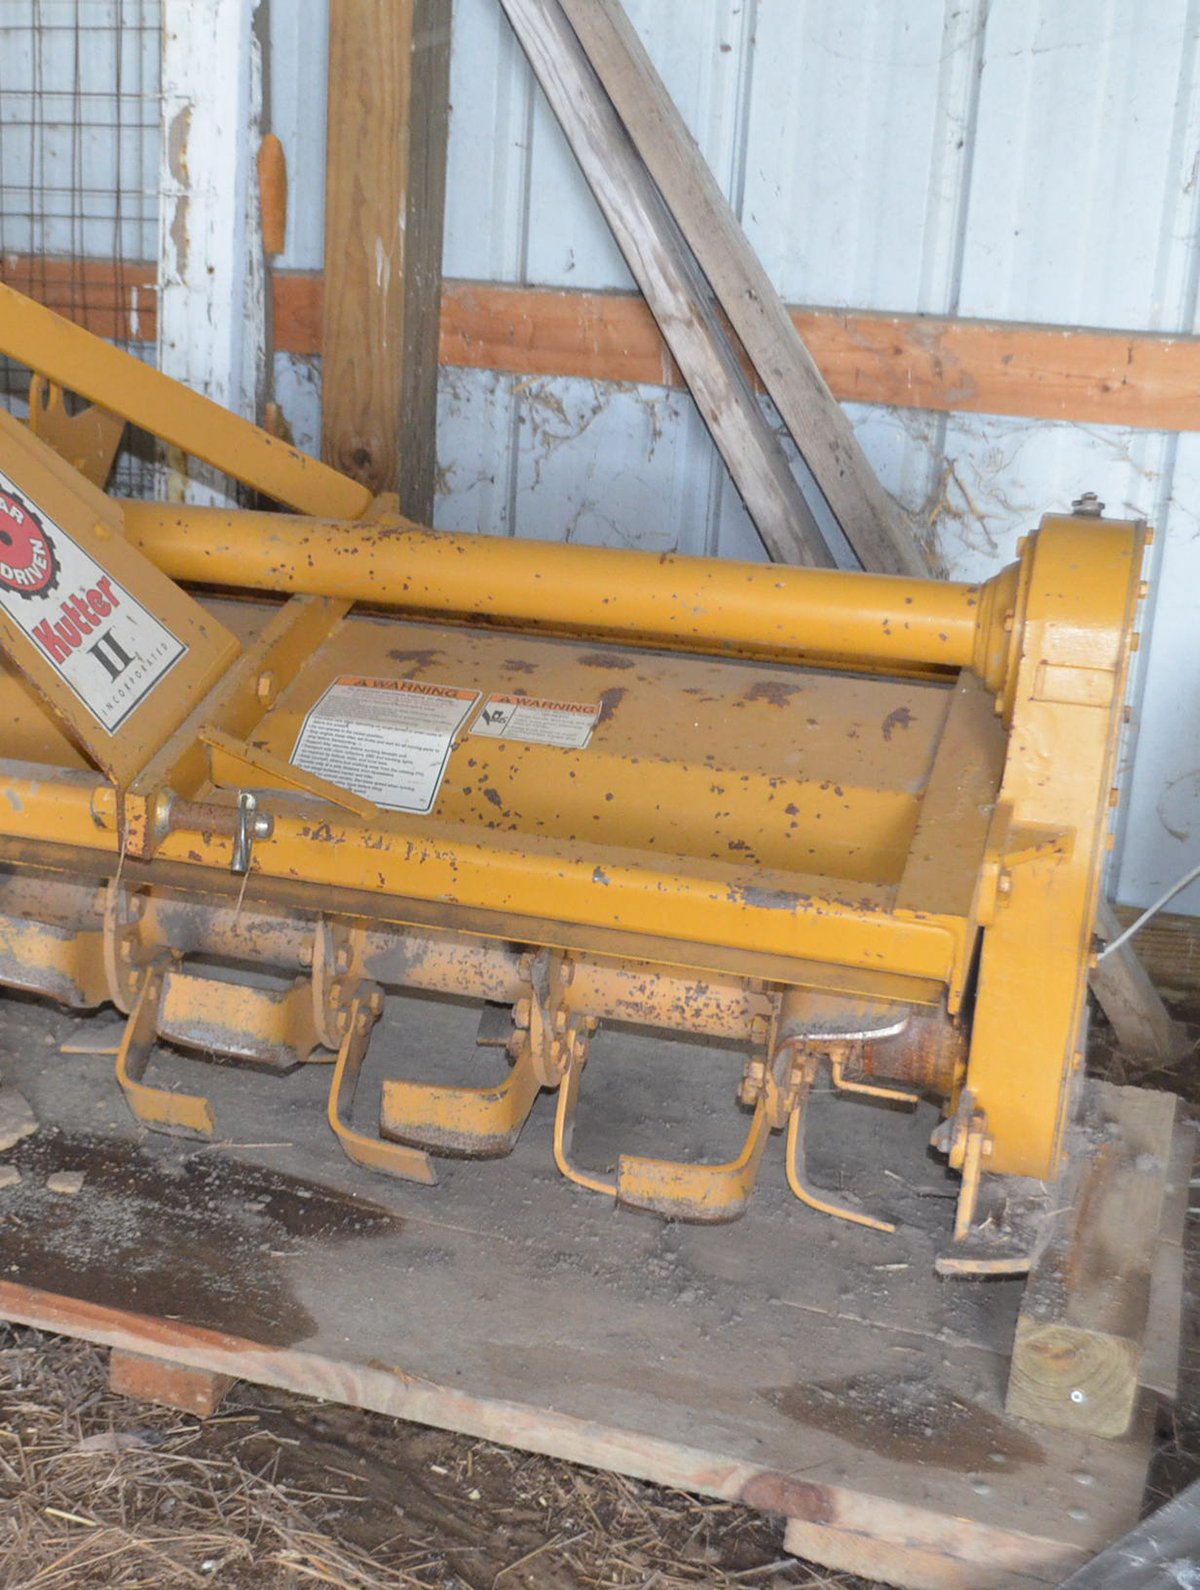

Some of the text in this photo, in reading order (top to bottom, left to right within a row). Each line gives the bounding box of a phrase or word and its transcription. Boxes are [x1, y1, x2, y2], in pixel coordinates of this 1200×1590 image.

[0, 537, 48, 586] DRIVEN
[32, 576, 120, 664] Kutter
[86, 626, 137, 684] II
[101, 642, 168, 716] INCORPORATED
[373, 679, 458, 698] WARNING
[516, 697, 596, 714] WARNING
